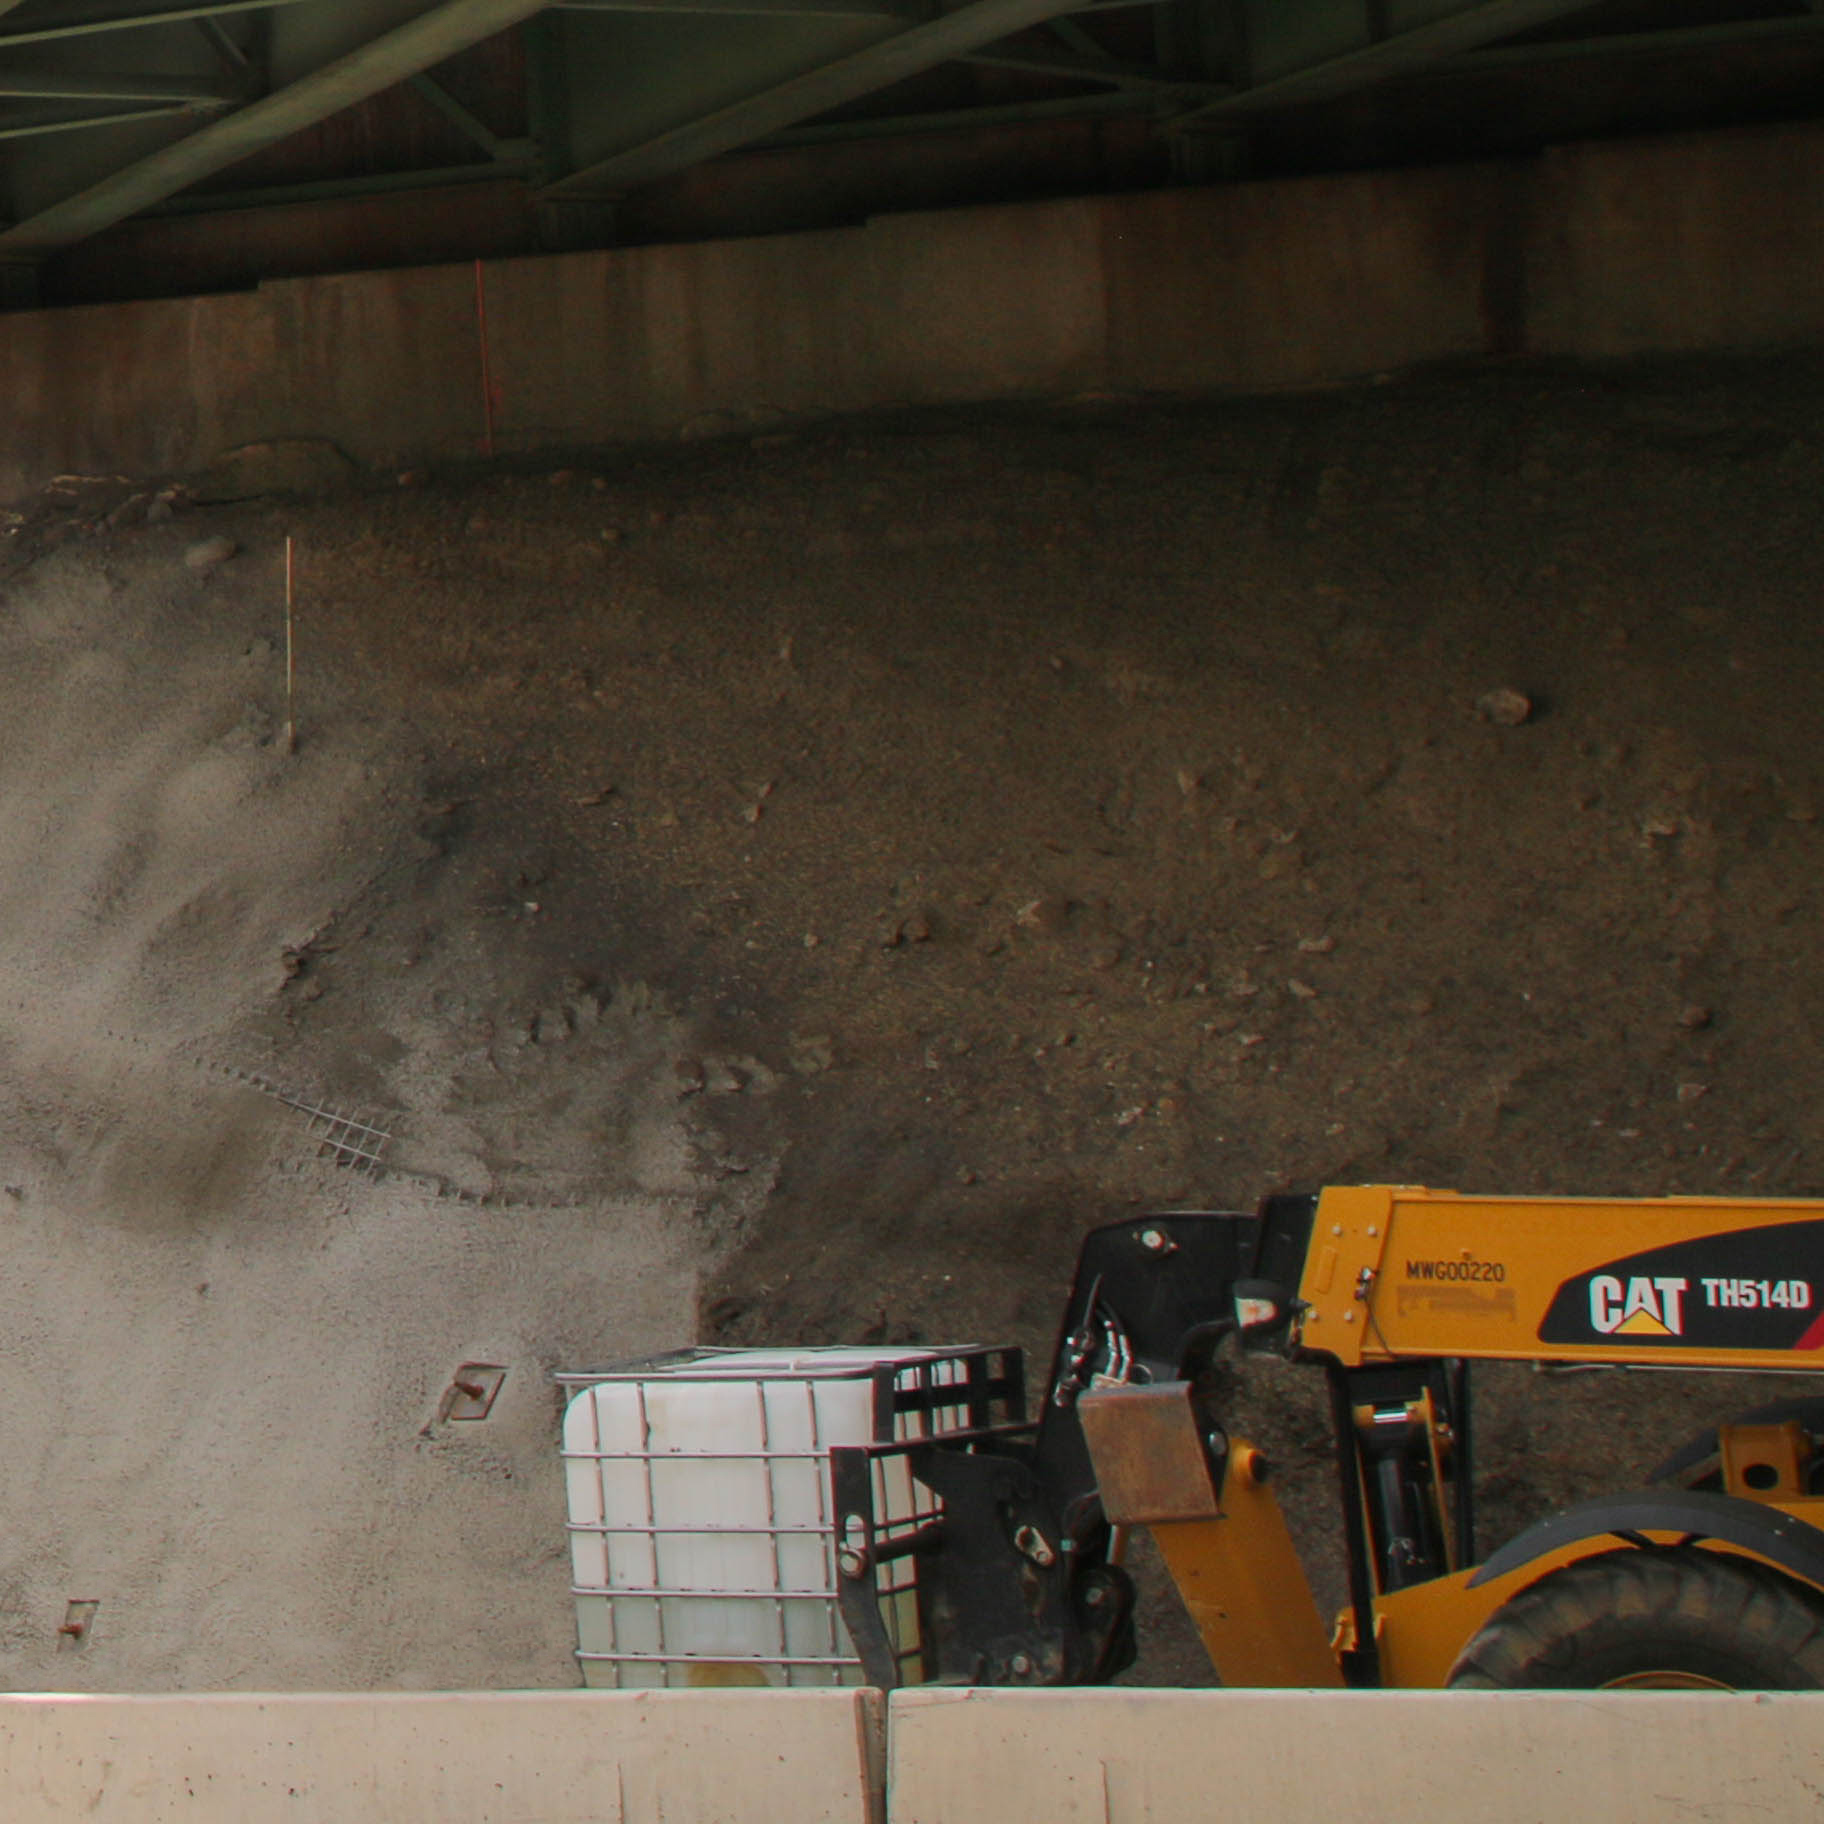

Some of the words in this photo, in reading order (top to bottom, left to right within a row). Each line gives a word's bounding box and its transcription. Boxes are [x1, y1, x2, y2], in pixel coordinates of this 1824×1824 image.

[1406, 1260, 1506, 1282] MWG00220
[1589, 1275, 1690, 1336] CAT
[1701, 1278, 1813, 1310] TH514D
